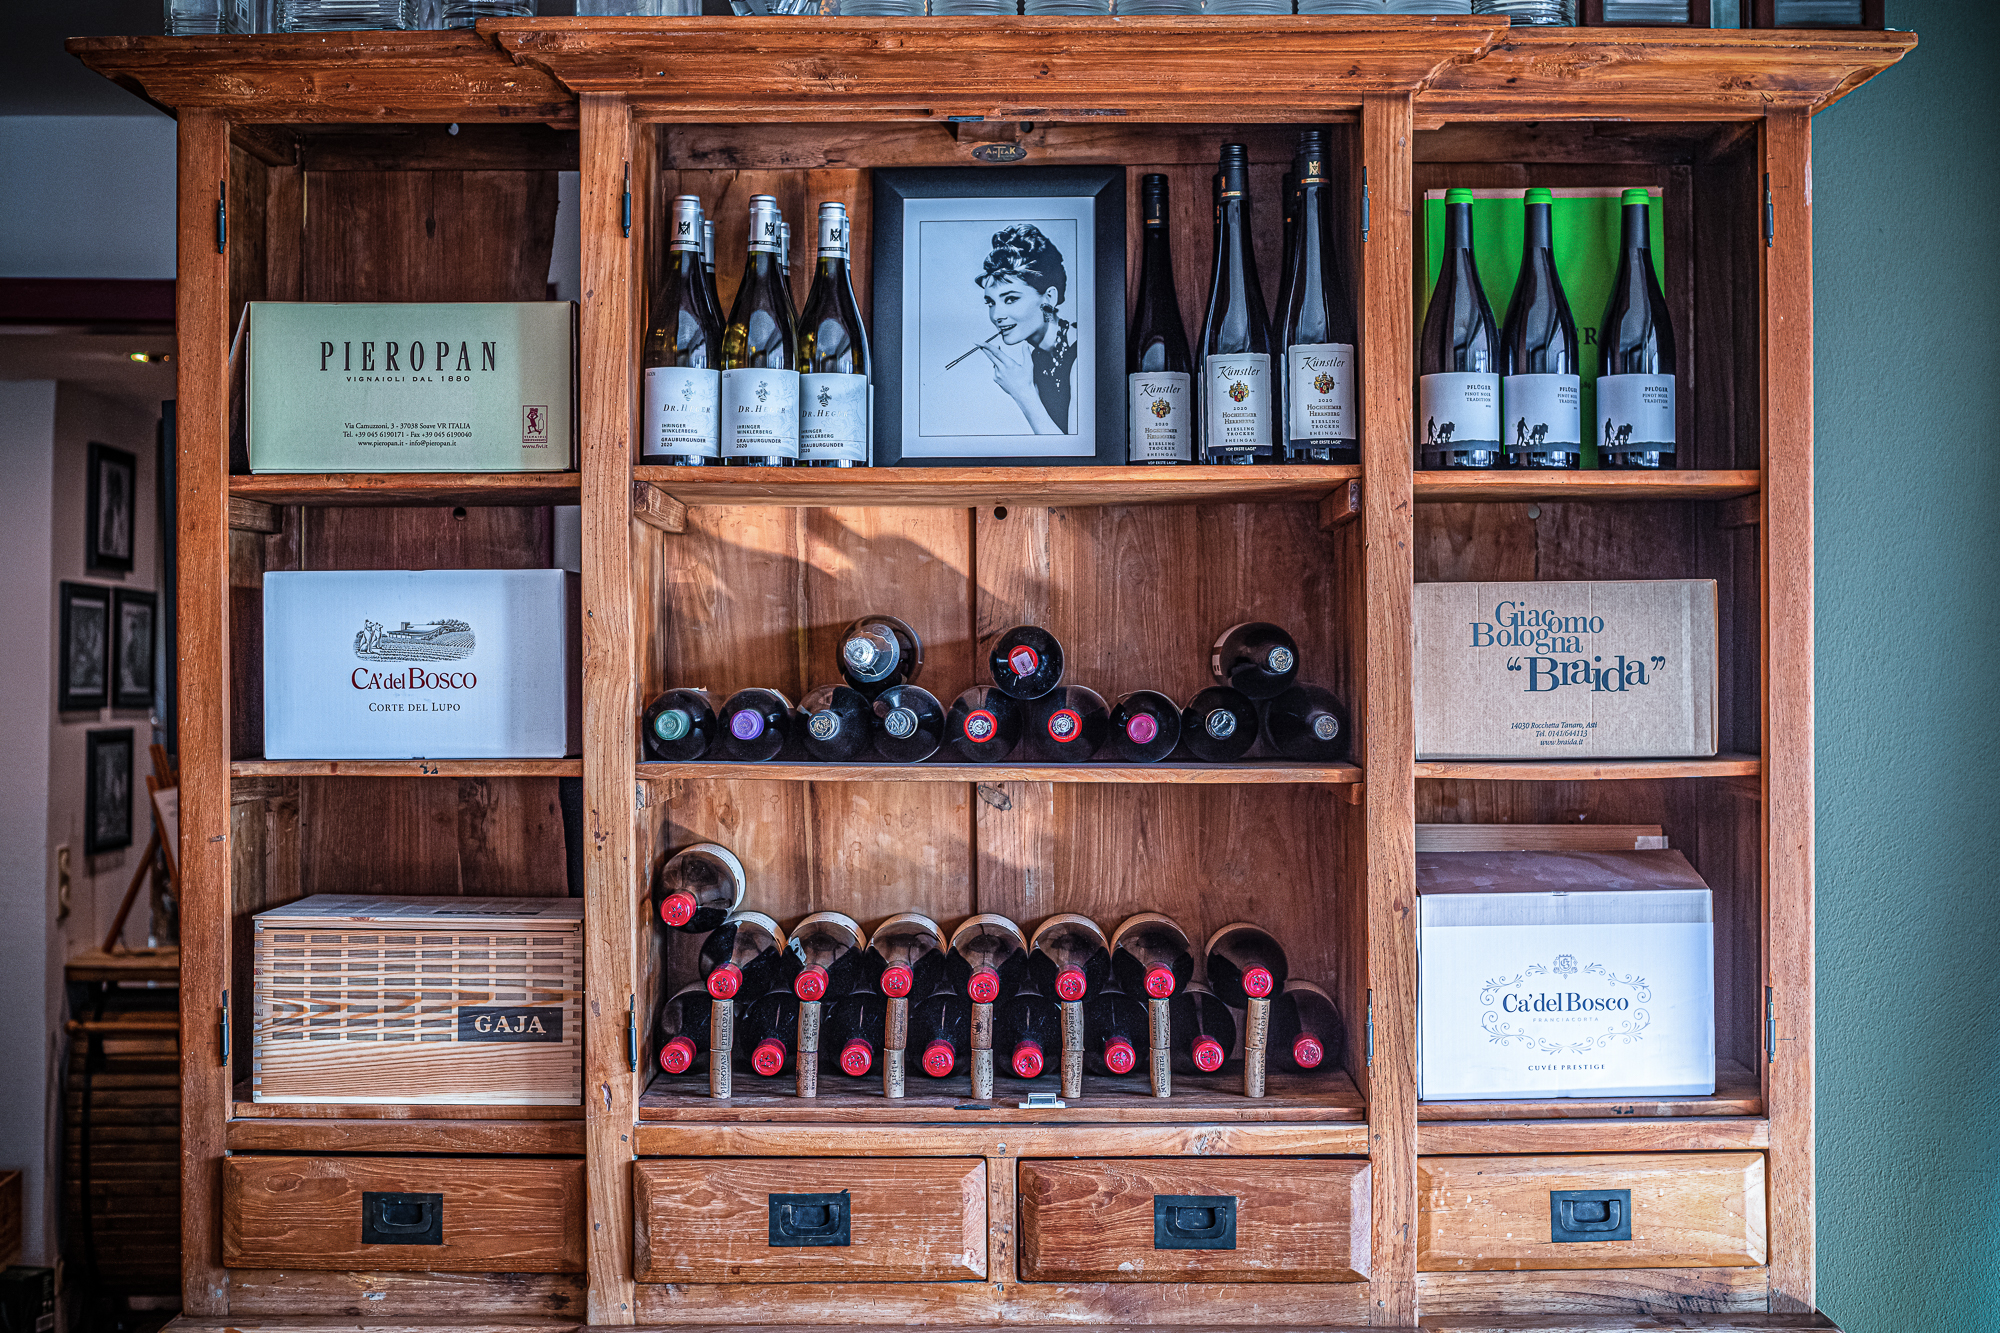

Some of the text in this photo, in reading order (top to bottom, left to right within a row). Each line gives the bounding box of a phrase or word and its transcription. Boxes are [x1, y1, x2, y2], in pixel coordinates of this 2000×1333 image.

[320, 341, 497, 372] PIEROPAN
[1301, 356, 1346, 371] Künstler
[1217, 365, 1261, 380] Künstler
[1139, 383, 1182, 397] Künstler
[1644, 385, 1669, 393] PFLÜGER
[344, 422, 355, 430] Via
[390, 422, 394, 430] 3
[400, 422, 418, 430] 37038
[419, 422, 436, 430] Soave
[436, 422, 447, 430] VR
[448, 422, 471, 430] ITALIA
[357, 440, 404, 448] www.pieropan.it
[409, 439, 457, 448] info@pieropan.it
[1494, 600, 1605, 634] Giacomo
[1469, 613, 1584, 655] Bologna
[408, 667, 478, 690] BOSCO
[368, 702, 461, 712] CORTE DEL LUPO
[1510, 721, 1531, 730] 14030
[1530, 721, 1560, 729] Rocchetta
[1560, 721, 1585, 729] Tanaro,
[1535, 729, 1588, 738] Tel. 0141/644113
[1540, 738, 1584, 746] www.braida.it
[1565, 992, 1629, 1012] Bosco
[474, 1015, 547, 1034] GAJA
[721, 1005, 729, 1046] PIEROPAN
[1068, 1007, 1076, 1047] PIEROPAN
[1259, 1004, 1267, 1045] PIEROPAN
[1527, 1063, 1606, 1071] CUVÉE PRESTIGE
